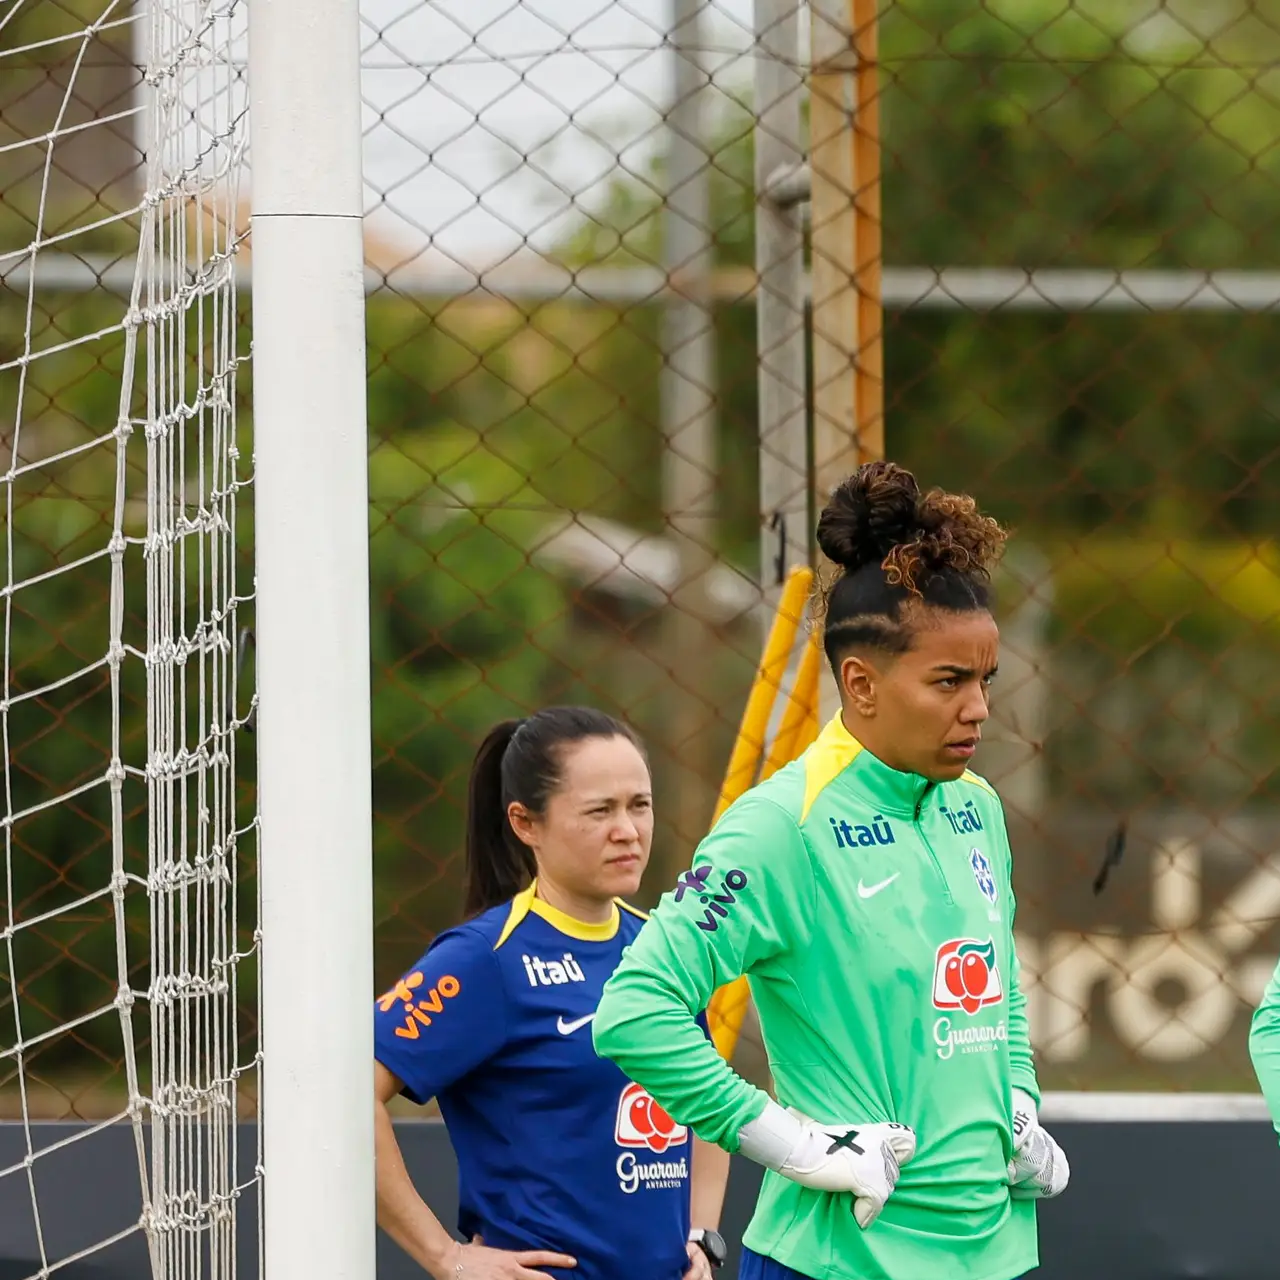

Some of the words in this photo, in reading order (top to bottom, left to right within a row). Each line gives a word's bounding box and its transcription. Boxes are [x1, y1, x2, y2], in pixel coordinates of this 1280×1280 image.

[828, 813, 896, 848] itaú
[938, 800, 984, 835] itaú
[694, 868, 748, 932] vivo
[522, 952, 587, 987] itaú
[394, 974, 461, 1040] vivo
[932, 1016, 1009, 1060] Guaraná
[616, 1152, 689, 1194] Guaraná
